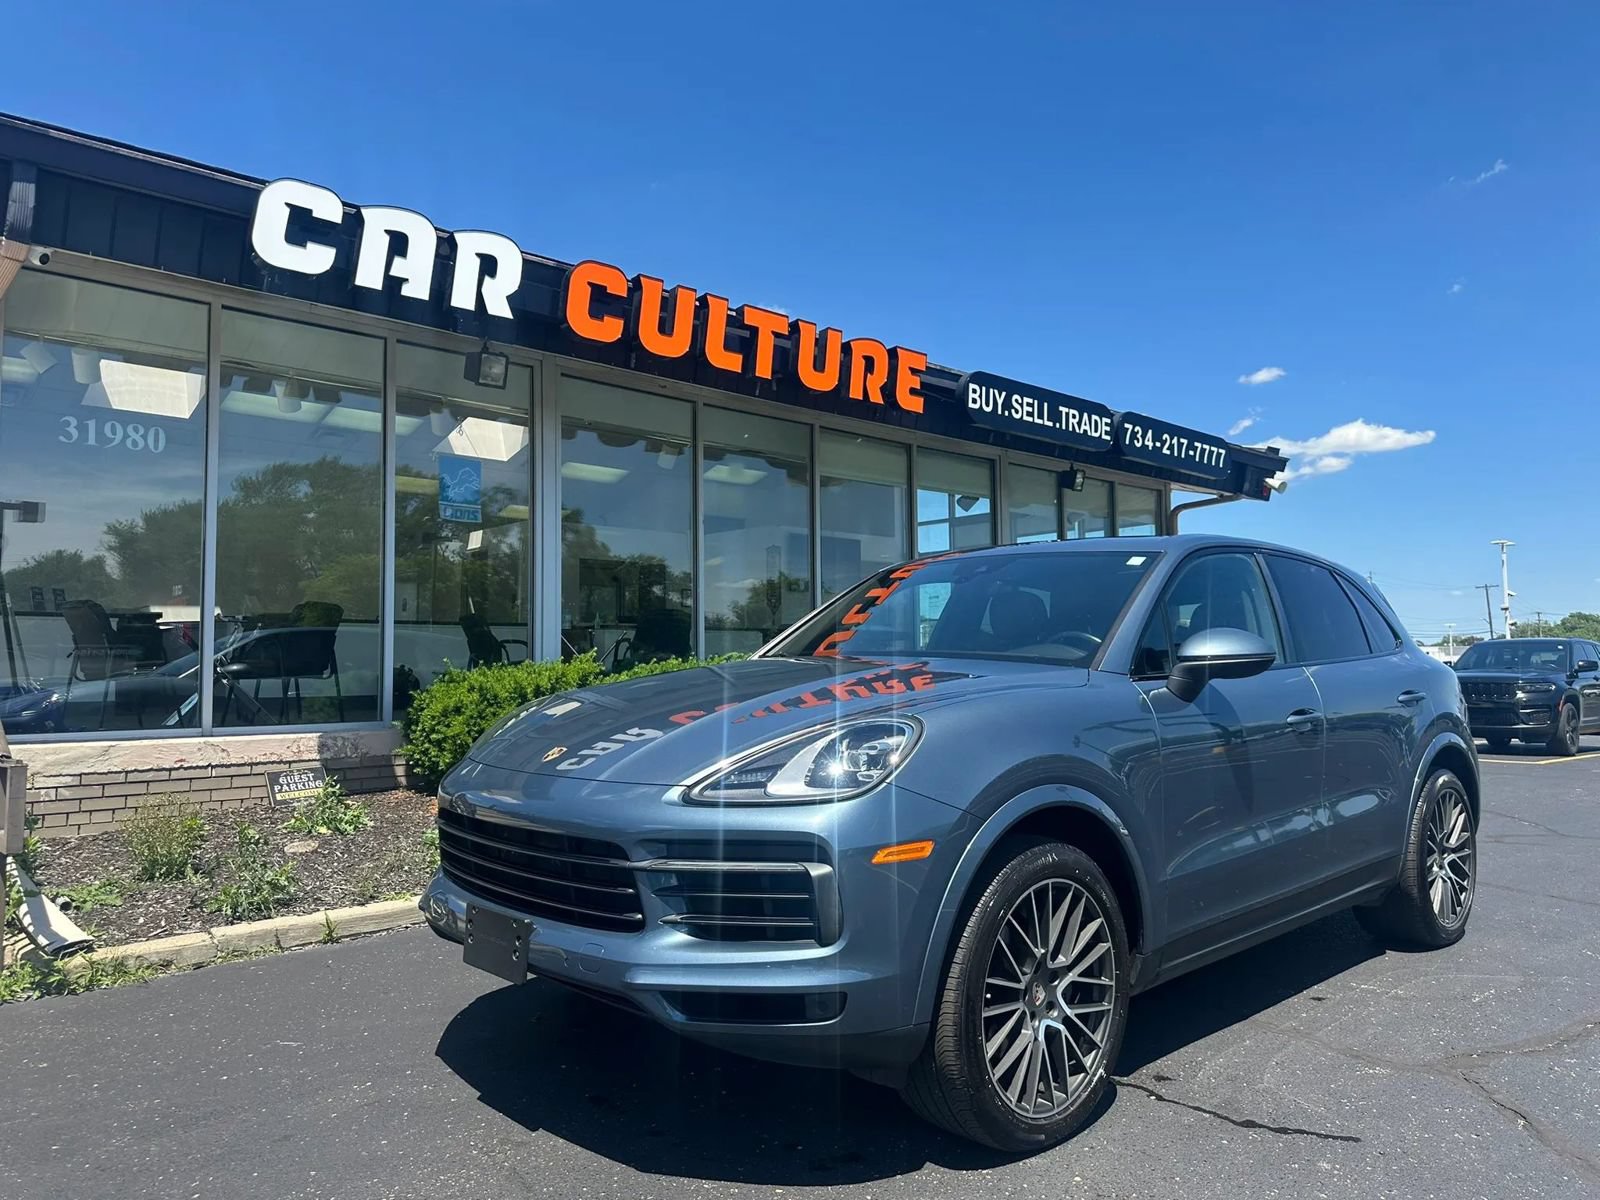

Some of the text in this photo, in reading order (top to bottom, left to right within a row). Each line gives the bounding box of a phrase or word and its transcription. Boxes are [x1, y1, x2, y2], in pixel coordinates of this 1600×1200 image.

[252, 180, 926, 413] CAR CULTURE
[58, 415, 166, 453] 31980
[1124, 422, 1226, 468] 734-217-7777
[274, 780, 322, 792] PARKING
[279, 773, 314, 784] GUEST
